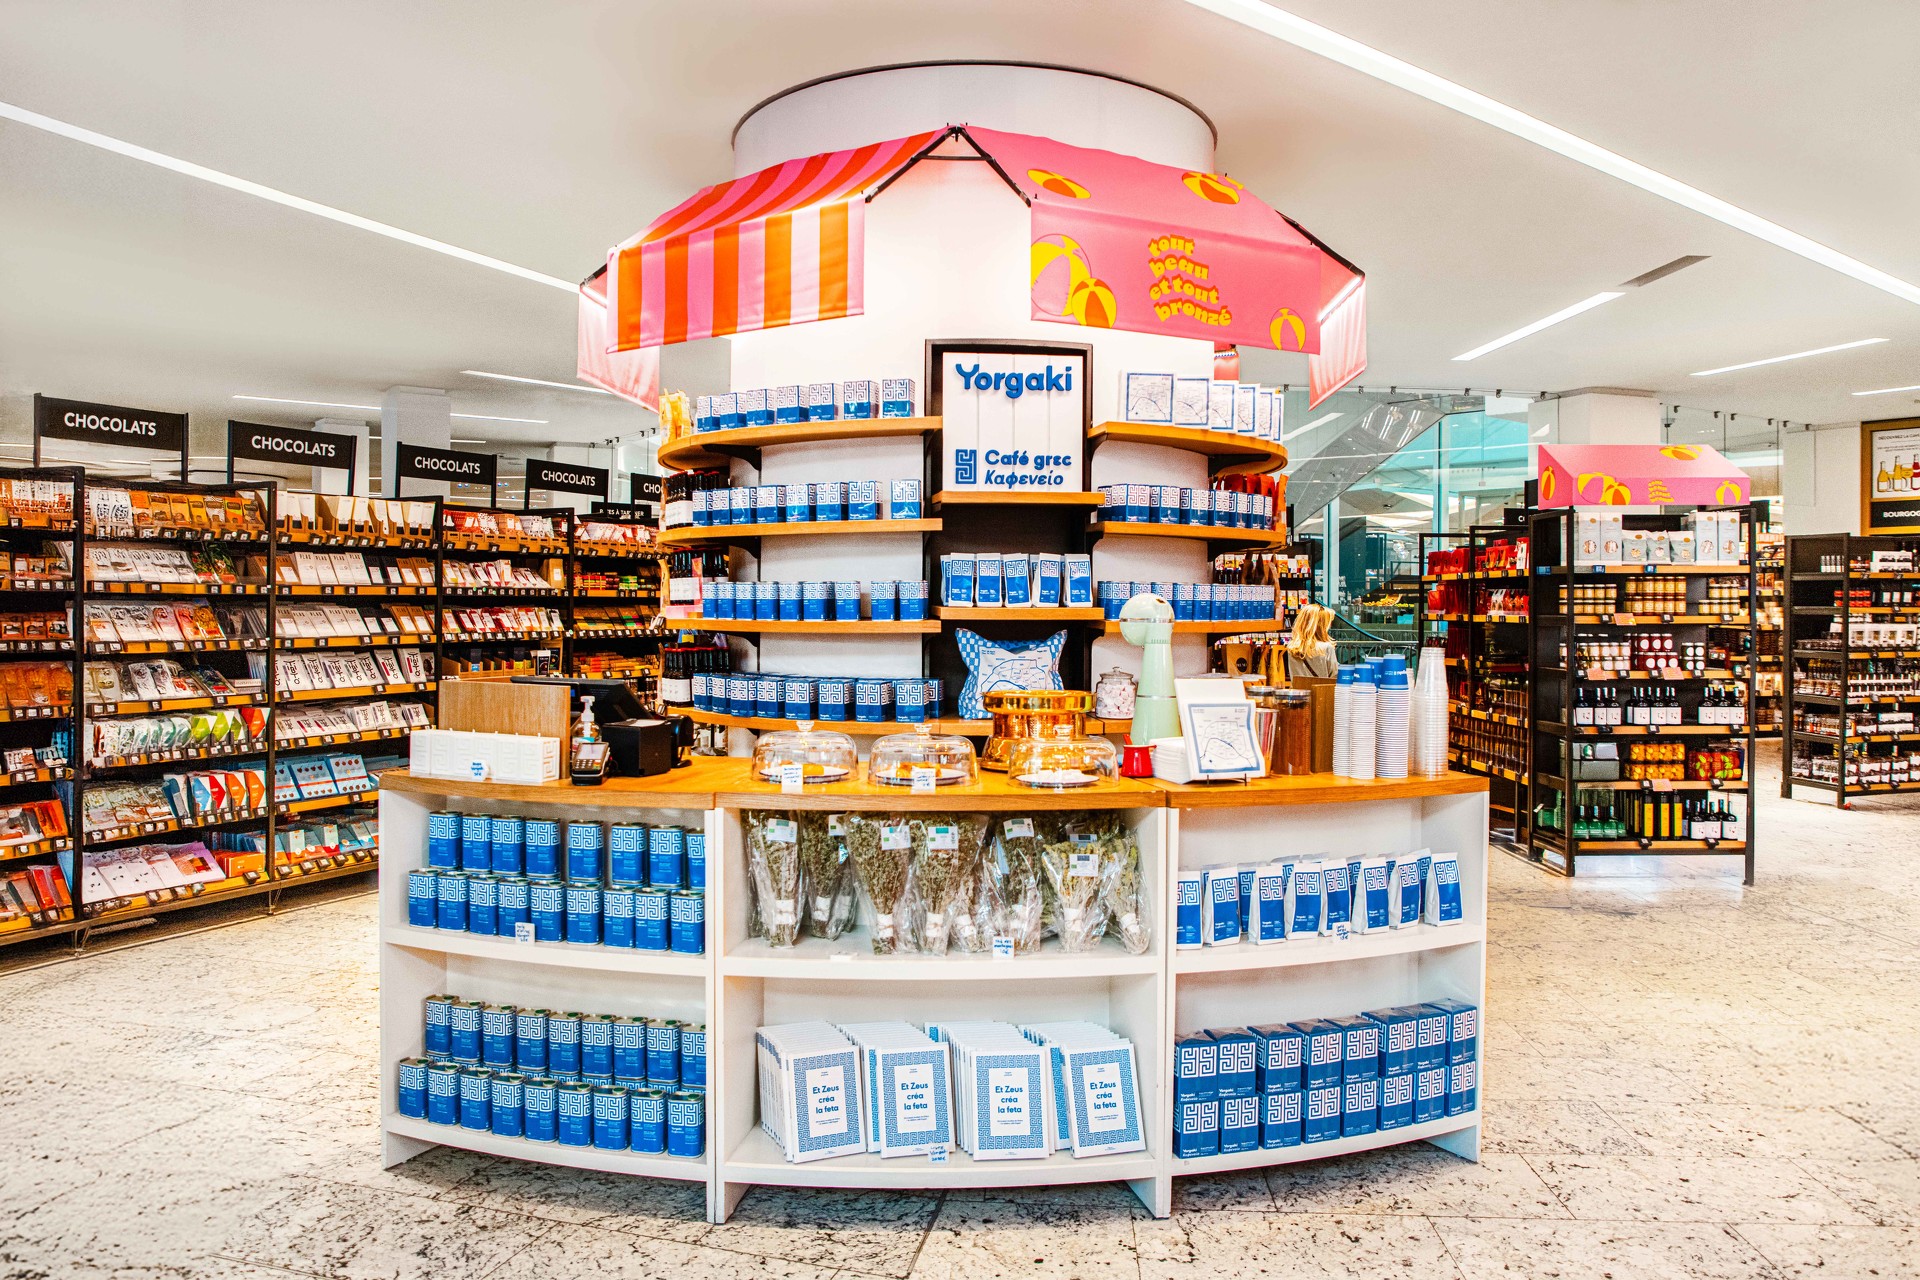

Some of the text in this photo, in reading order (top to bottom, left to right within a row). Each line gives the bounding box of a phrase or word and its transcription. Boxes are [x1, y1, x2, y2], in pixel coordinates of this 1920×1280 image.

[1148, 235, 1195, 257] tout
[1148, 254, 1209, 280] beau
[1149, 275, 1219, 304] et tout
[1154, 298, 1232, 326] bronzé
[955, 364, 1072, 398] Yorgaki
[64, 412, 156, 436] CHOCOLATS
[252, 435, 336, 458] CHOCOLATS
[985, 450, 1029, 465] Café
[415, 457, 480, 474] CHOCOLATS
[542, 470, 596, 486] CHOCOLATS
[1099, 1081, 1116, 1089] Zeus
